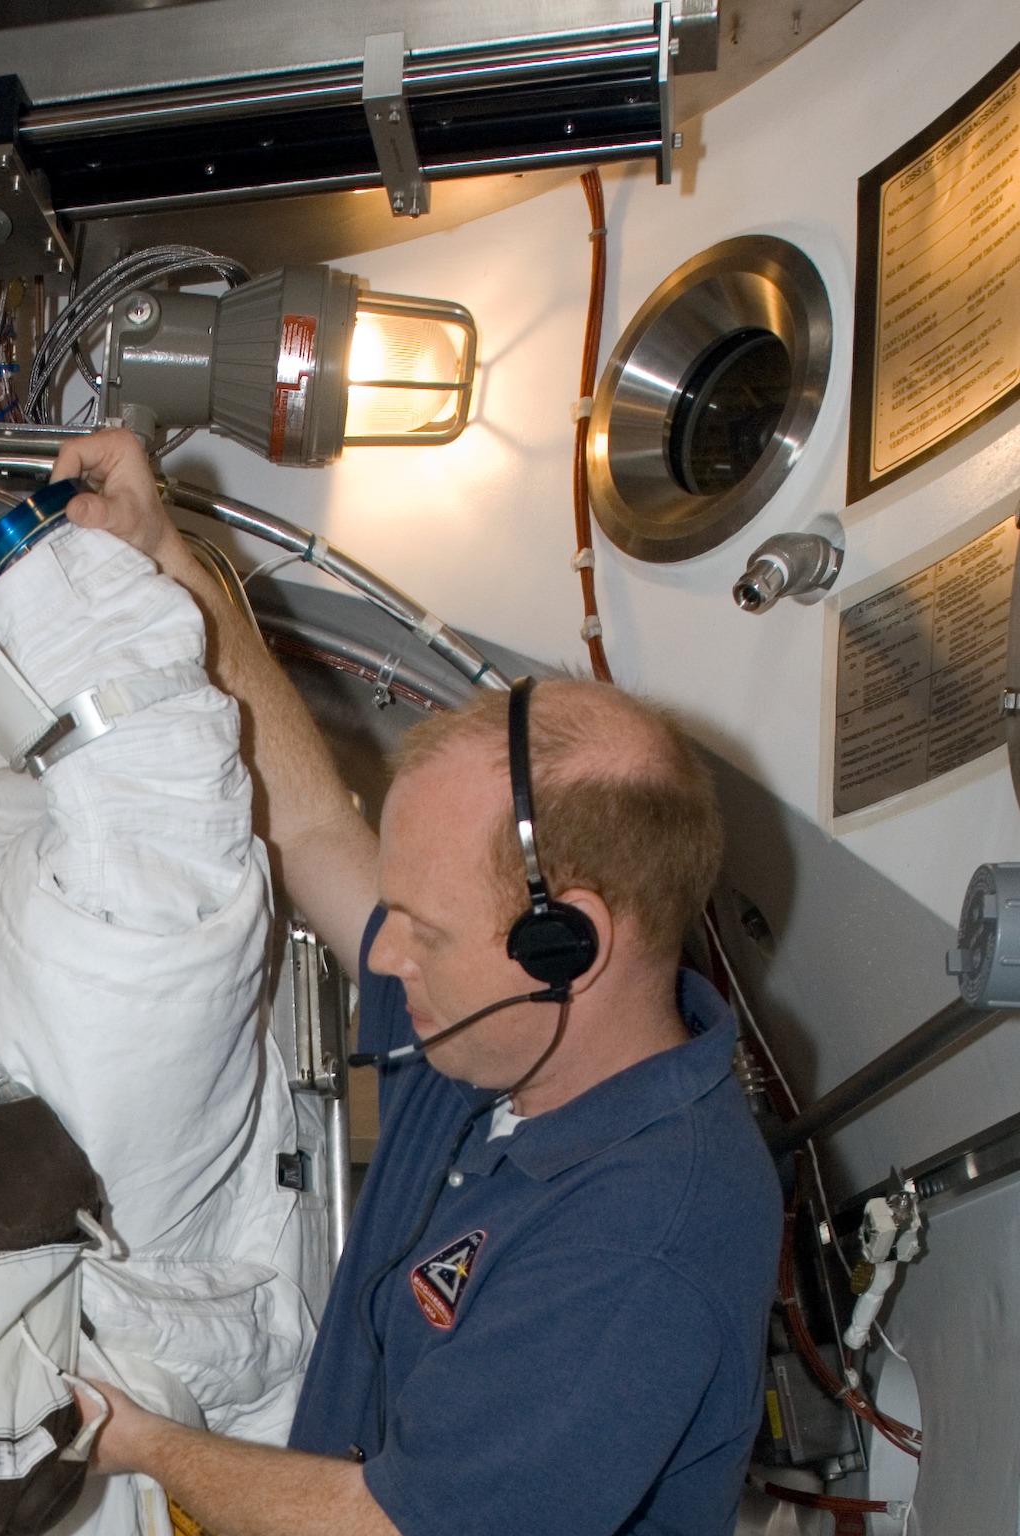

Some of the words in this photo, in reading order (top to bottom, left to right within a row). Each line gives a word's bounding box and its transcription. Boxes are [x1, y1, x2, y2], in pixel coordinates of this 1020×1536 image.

[899, 166, 921, 188] LOSS
[923, 156, 933, 170] OF
[935, 135, 960, 160] COMM
[962, 84, 1016, 138] HANDSIGNALS
